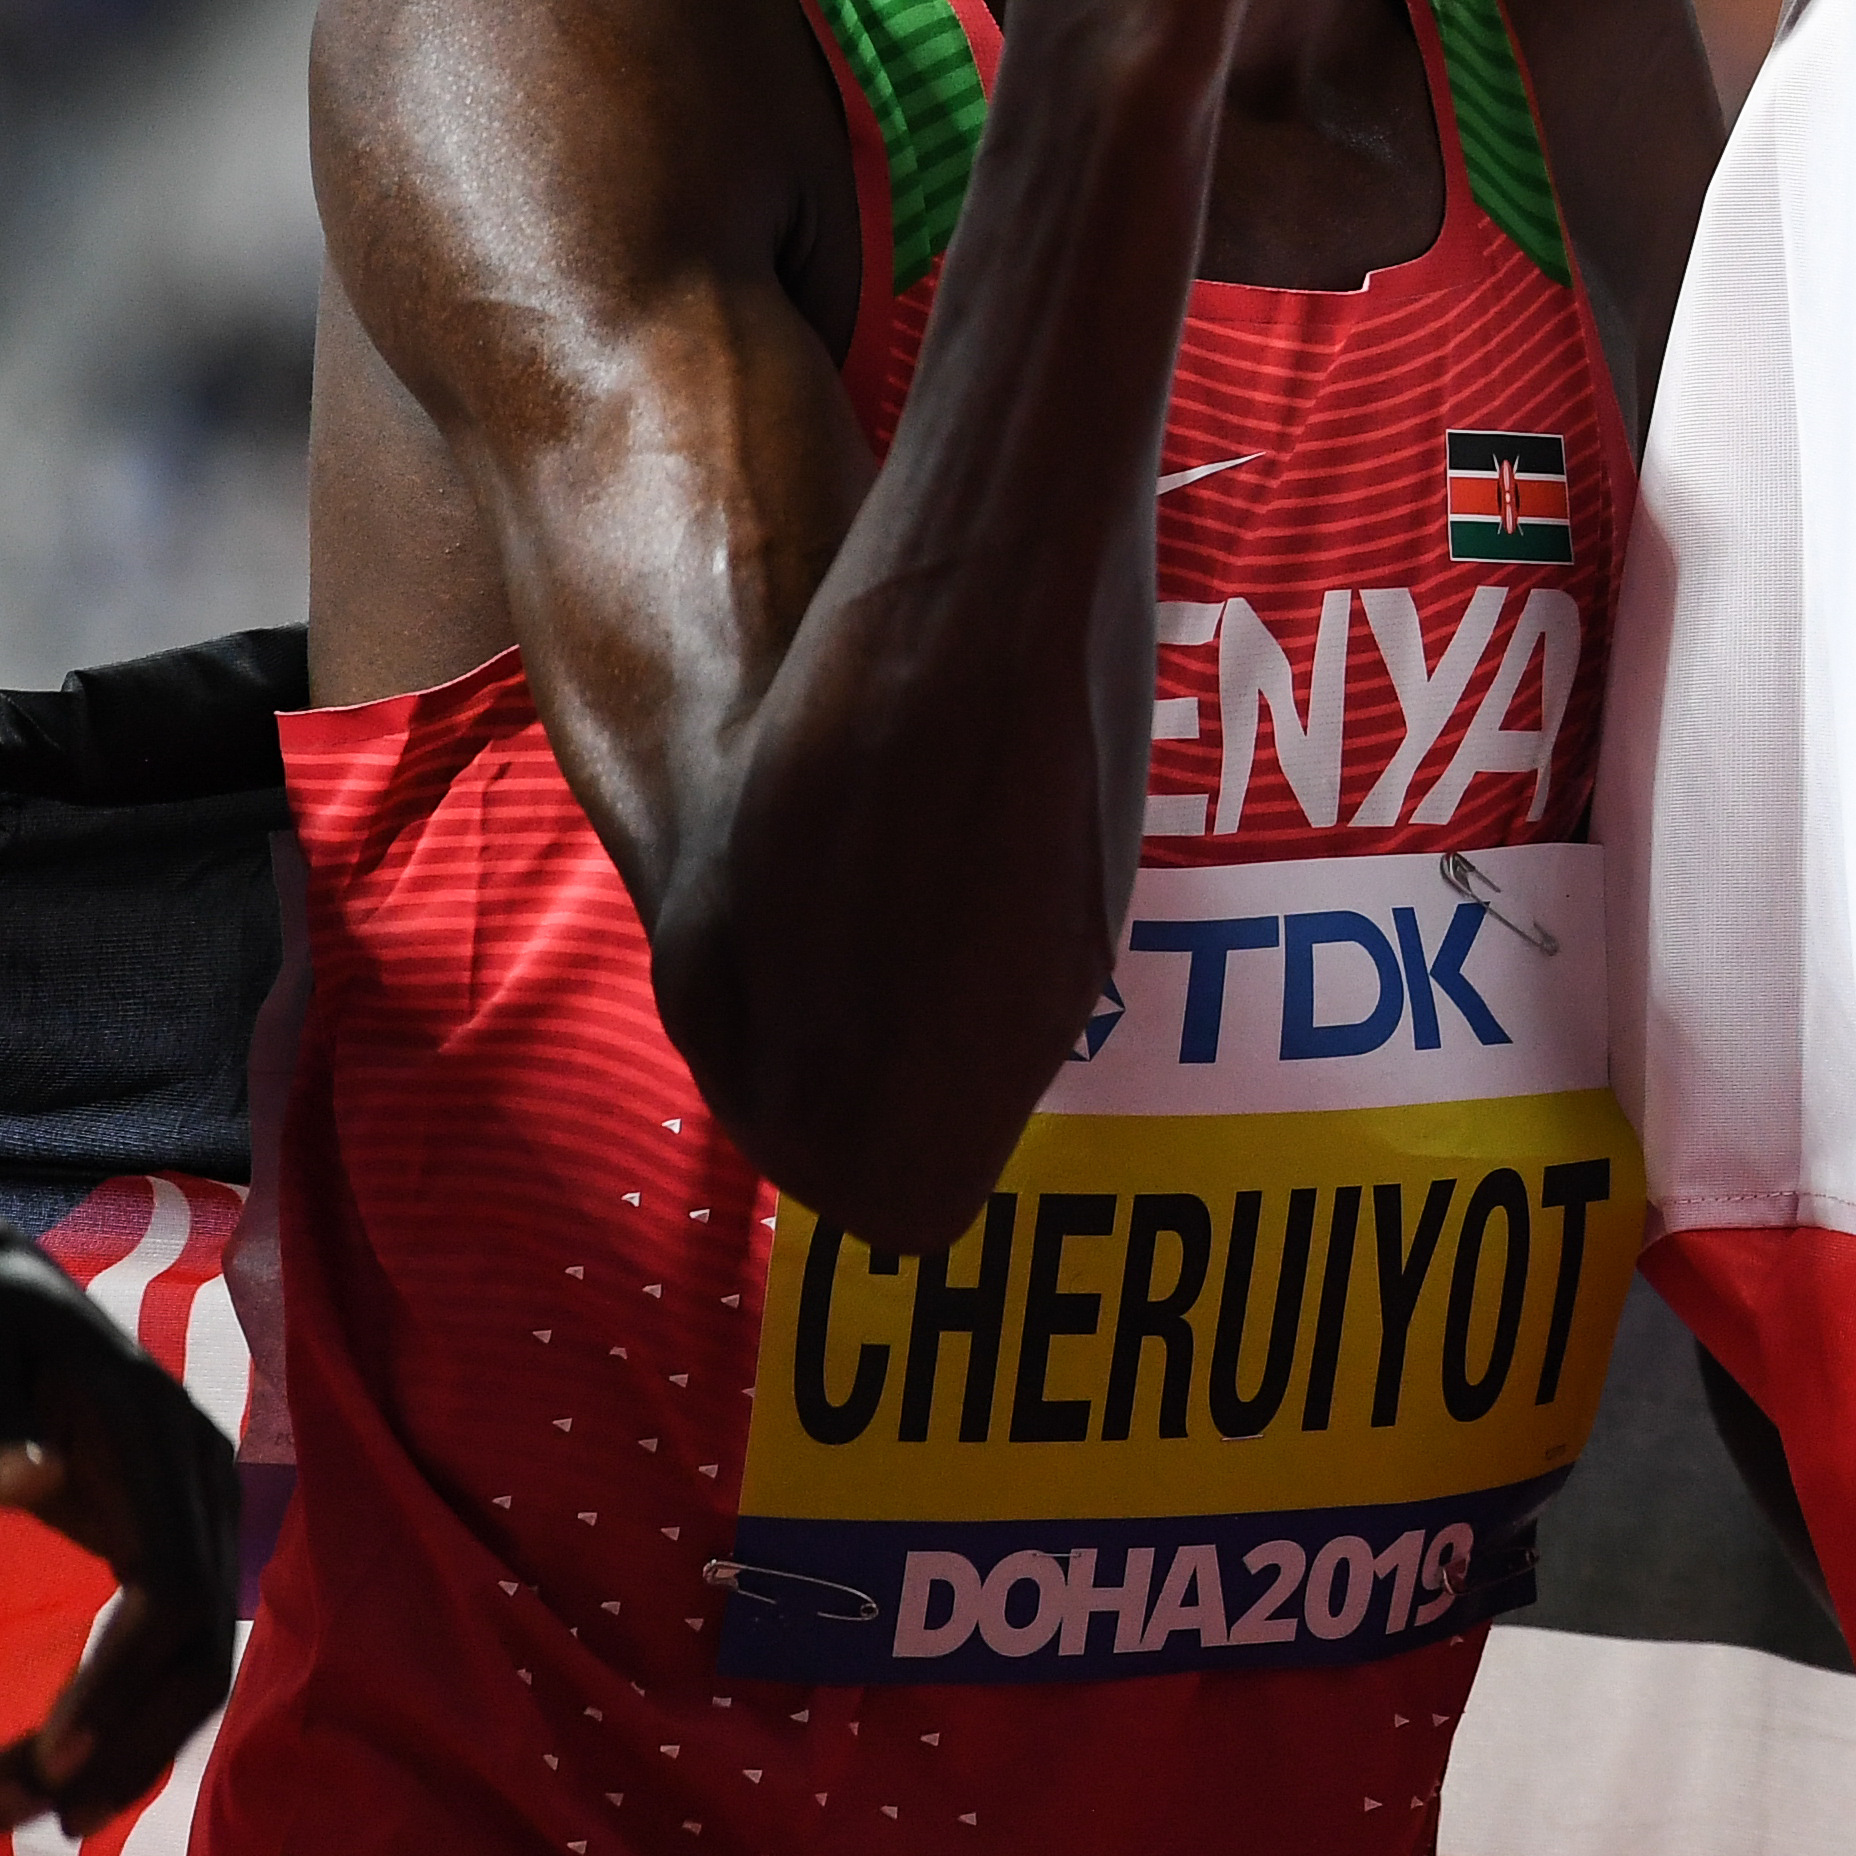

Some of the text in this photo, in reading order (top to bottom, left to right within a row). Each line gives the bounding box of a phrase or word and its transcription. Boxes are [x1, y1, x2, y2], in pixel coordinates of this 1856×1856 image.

[1143, 586, 1582, 836] ENYA
[1129, 900, 1514, 1064] TDK
[793, 1158, 1610, 1445] CHERUIYOT
[892, 1521, 1475, 1658] DOHA2019
